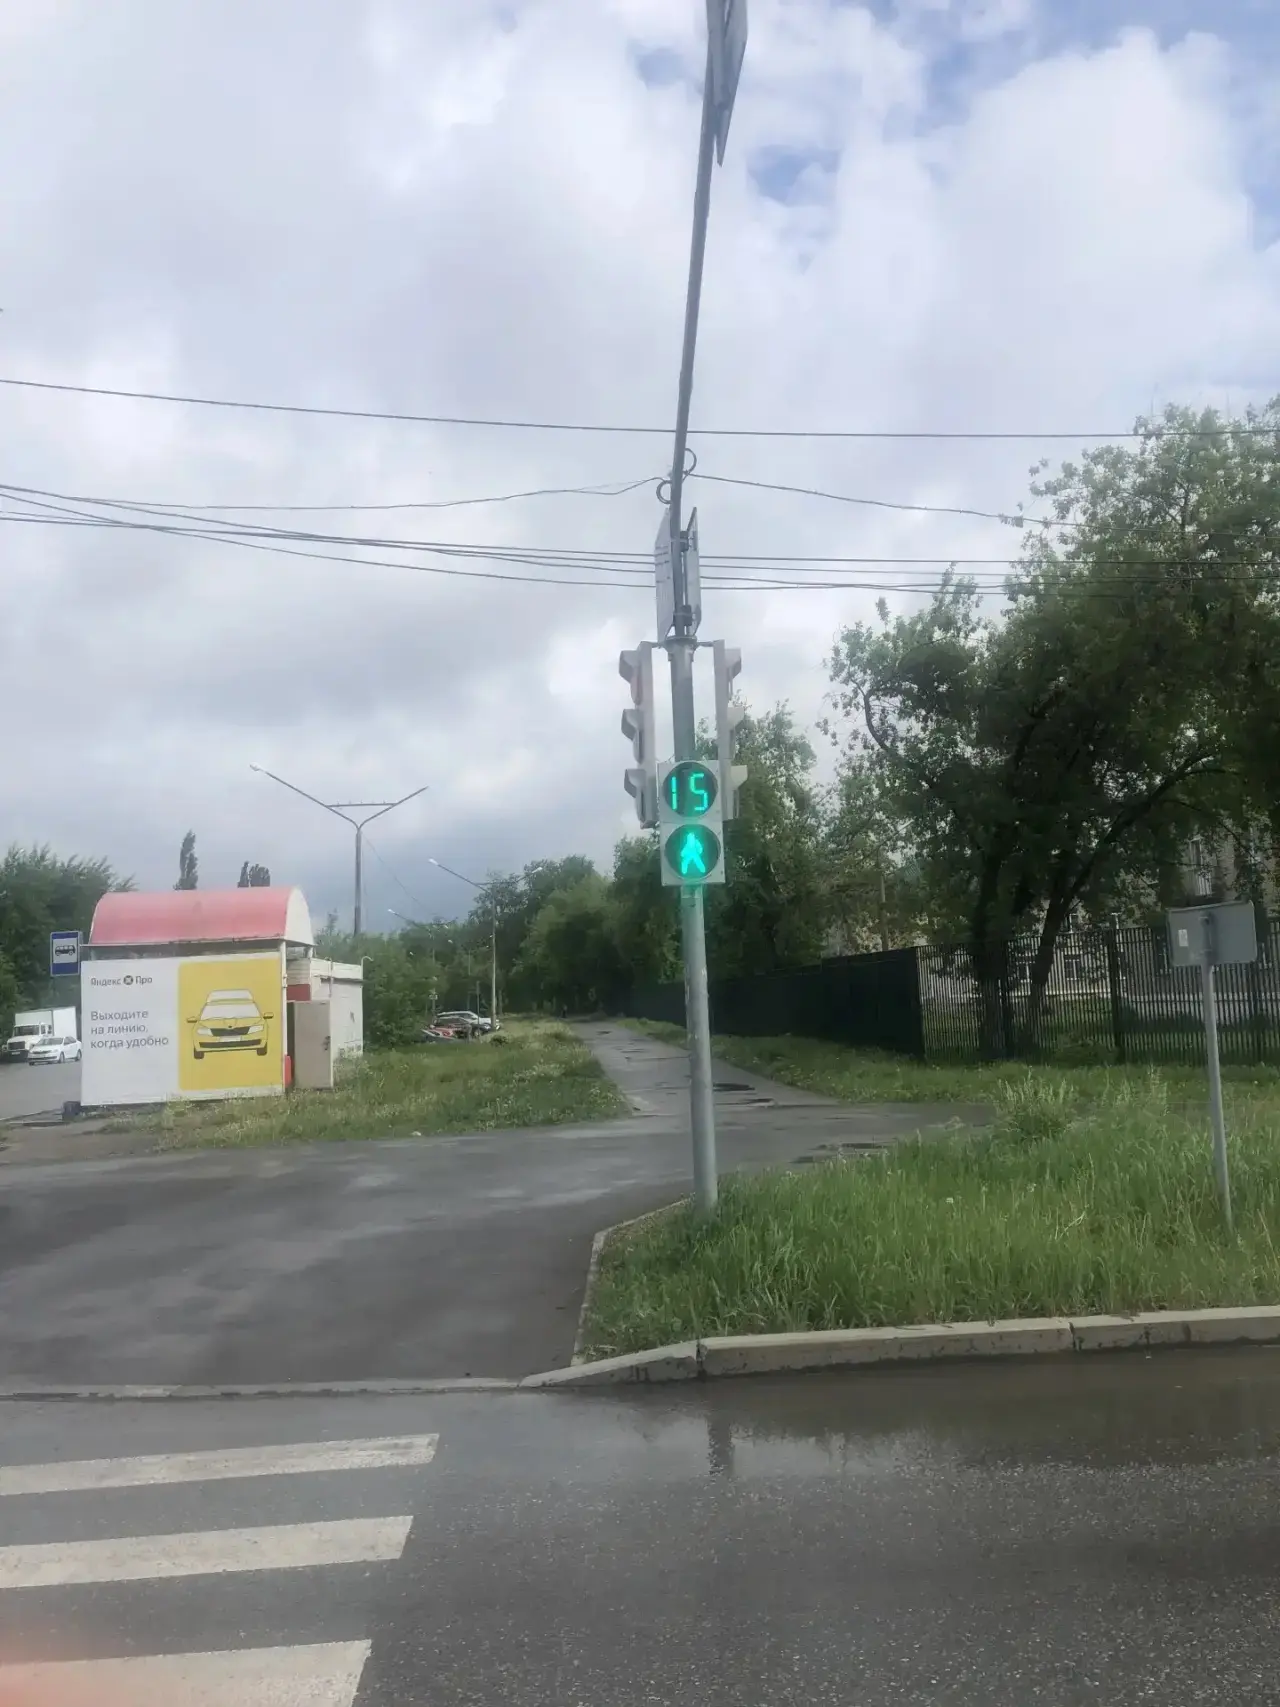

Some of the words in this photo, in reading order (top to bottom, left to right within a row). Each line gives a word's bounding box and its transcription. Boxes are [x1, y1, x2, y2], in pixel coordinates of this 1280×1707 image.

[671, 773, 708, 810] 15
[91, 977, 121, 986] Яндекс
[135, 976, 153, 985] Про
[91, 1010, 149, 1021] Выходите
[91, 1026, 104, 1035] на
[107, 1025, 148, 1034] линию,
[91, 1040, 123, 1049] когда
[126, 1035, 169, 1049] удобно
